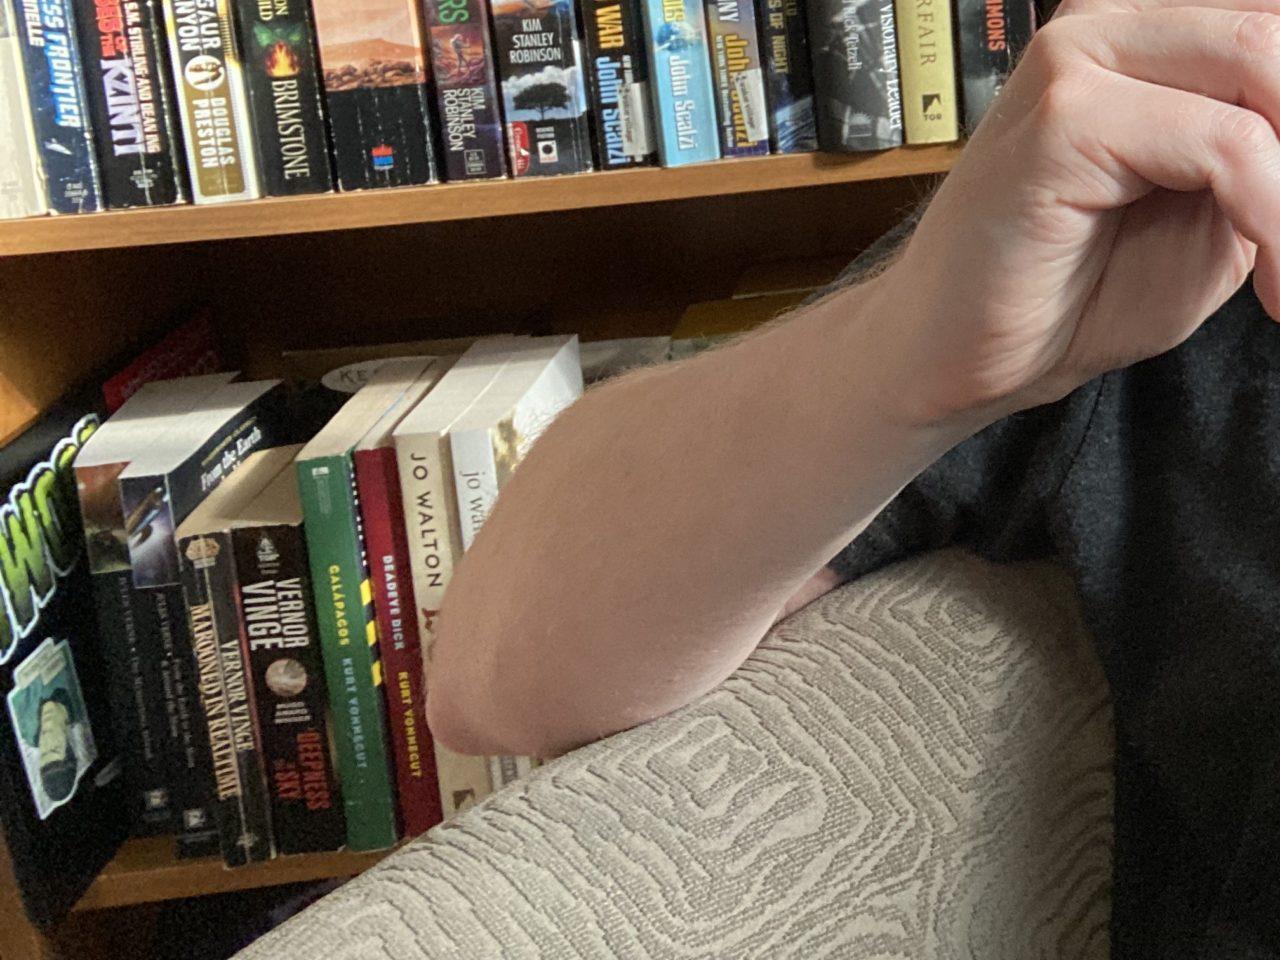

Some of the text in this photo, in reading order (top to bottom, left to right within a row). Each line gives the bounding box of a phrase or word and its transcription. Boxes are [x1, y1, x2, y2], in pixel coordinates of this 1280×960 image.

[509, 48, 562, 63] ROBINSON
[512, 33, 555, 49] STANLEY
[521, 19, 542, 33] KIM
[596, 6, 625, 49] WAR
[771, 35, 790, 74] NIGHT
[43, 32, 80, 128] FRONTIER
[101, 59, 145, 156] KZINTI
[456, 87, 478, 139] STANLEY
[471, 88, 486, 110] KIM
[669, 55, 699, 150] John Scalzi
[192, 98, 218, 169] PRESTON
[209, 97, 236, 166] DOUGLAS
[270, 79, 310, 179] BRIMSTONE
[443, 89, 464, 153] ROBINSON
[460, 469, 483, 491] jo
[411, 452, 443, 588] JO WALTON
[242, 580, 284, 651] VINGE
[275, 577, 310, 648] VERNOR
[190, 603, 240, 800] MAROONED REALTIME
[220, 640, 254, 751] VERNOR VINGE
[328, 565, 368, 770] GALÁPAGOS VONNEGUT
[382, 555, 423, 777] DEADEYE KURT VONNEGUT
[296, 730, 331, 810] DEEPNESS
